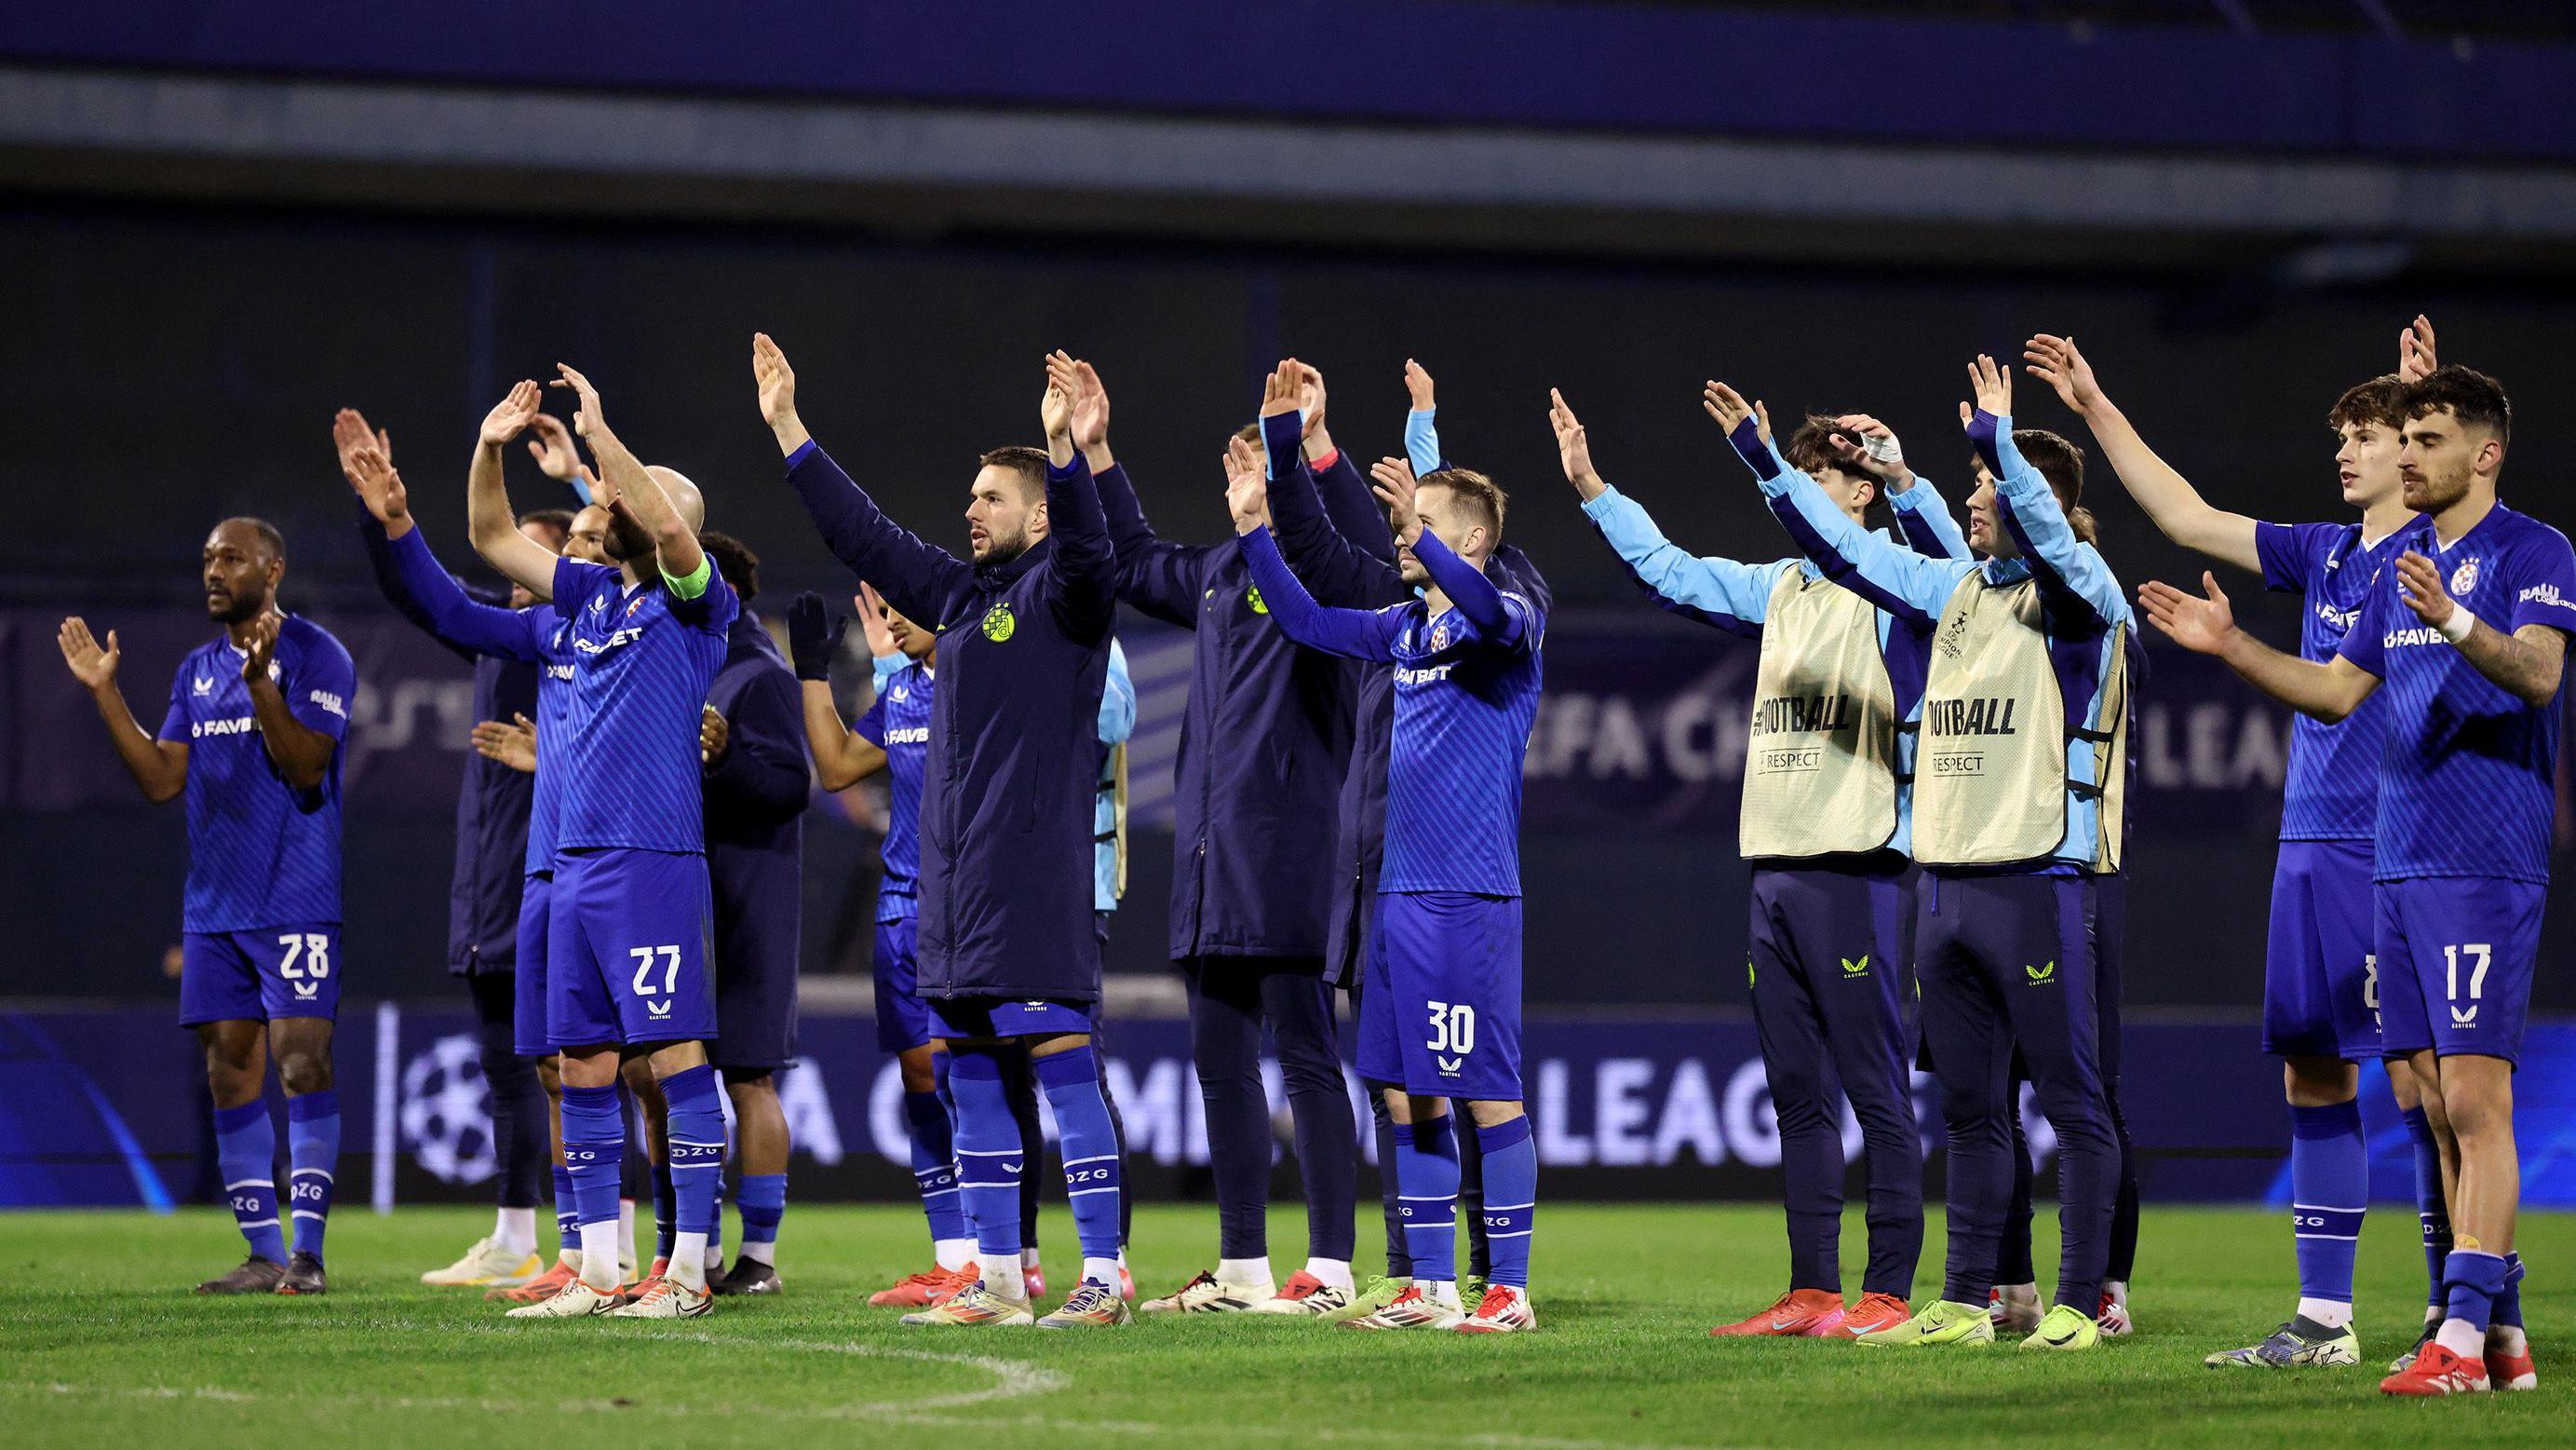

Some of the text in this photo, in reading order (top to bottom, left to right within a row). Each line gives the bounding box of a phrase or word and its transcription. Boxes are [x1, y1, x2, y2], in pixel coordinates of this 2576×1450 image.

[2397, 627, 2450, 648] FAVB
[889, 727, 929, 745] FAVB
[2142, 701, 2286, 789] LEA
[1767, 752, 1820, 768] RESPECT
[1934, 757, 1984, 772] RESPECT
[279, 933, 329, 979] 28
[630, 945, 681, 996] 27
[2444, 944, 2490, 1000] 17
[1427, 1000, 1475, 1054] 30
[563, 1150, 596, 1160] ZG
[917, 1174, 951, 1189] ZG
[1067, 1168, 1108, 1184] DZG
[230, 1196, 260, 1212] ZG
[1484, 1216, 1511, 1226] ZG
[2294, 1215, 2325, 1226] ZG
